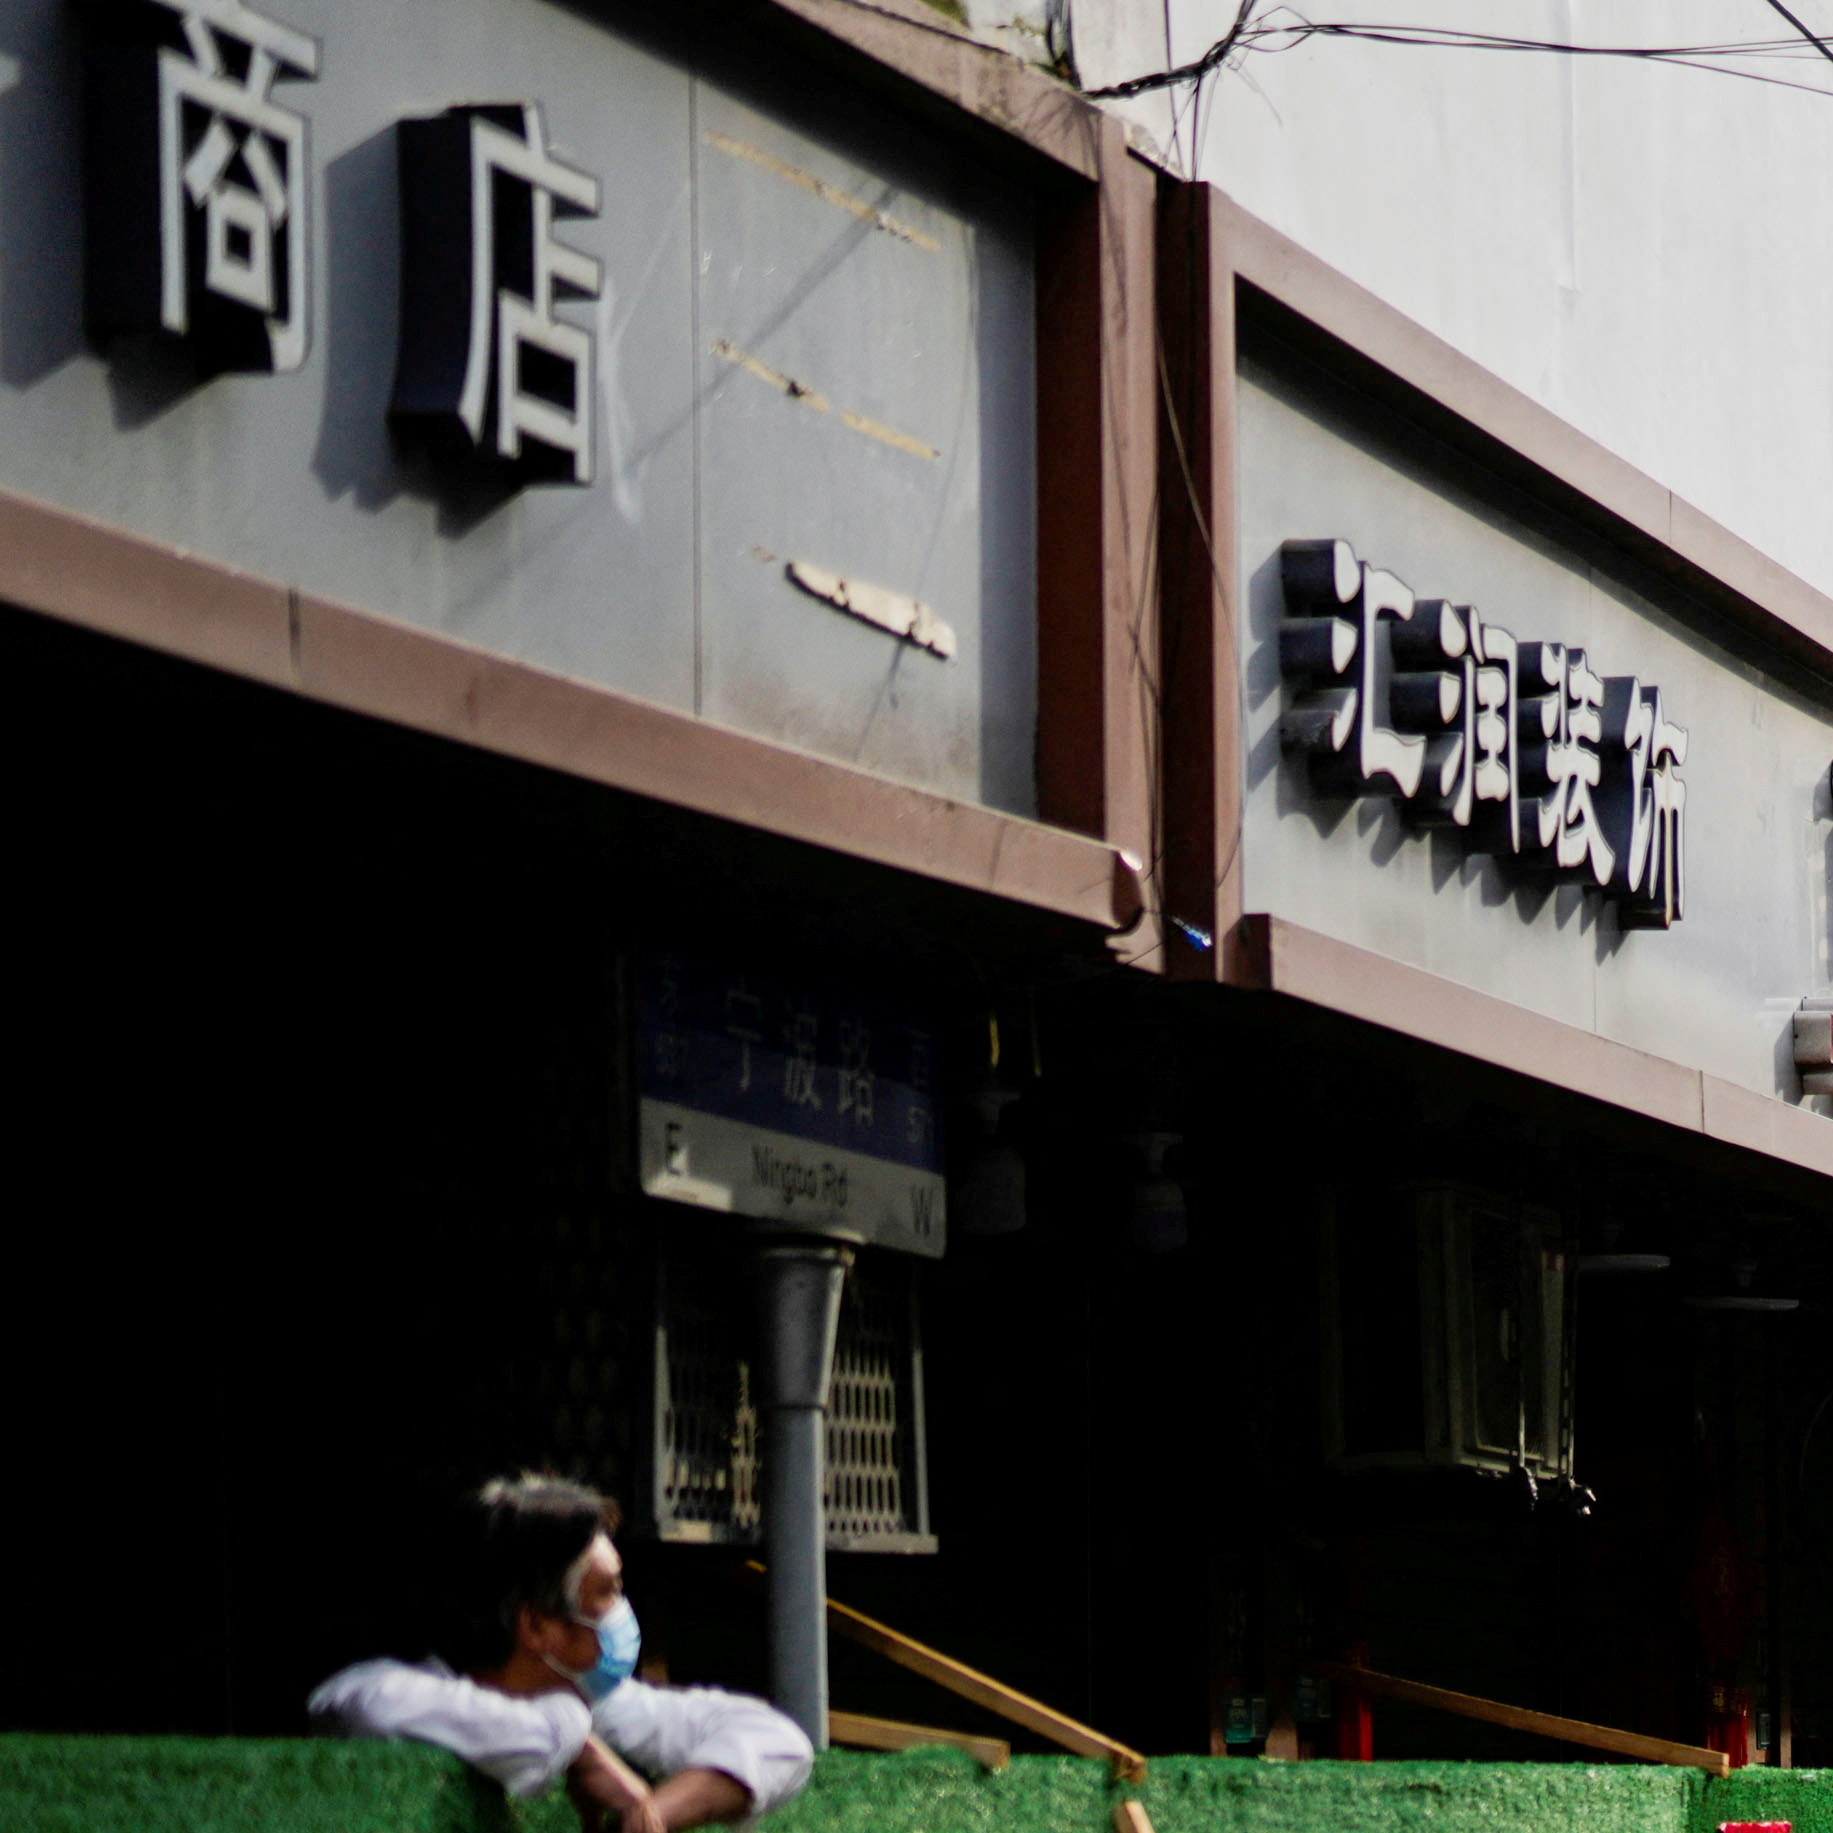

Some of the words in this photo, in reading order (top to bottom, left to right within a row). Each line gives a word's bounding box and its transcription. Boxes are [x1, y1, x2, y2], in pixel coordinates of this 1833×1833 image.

[158, 0, 602, 485] 商店
[1331, 537, 1690, 930] 汇润装饰
[724, 973, 876, 1129] 宁波路
[664, 1121, 683, 1177] E
[751, 1144, 818, 1205] Ningbo
[820, 1162, 849, 1208] Rd
[910, 1184, 934, 1237] W
